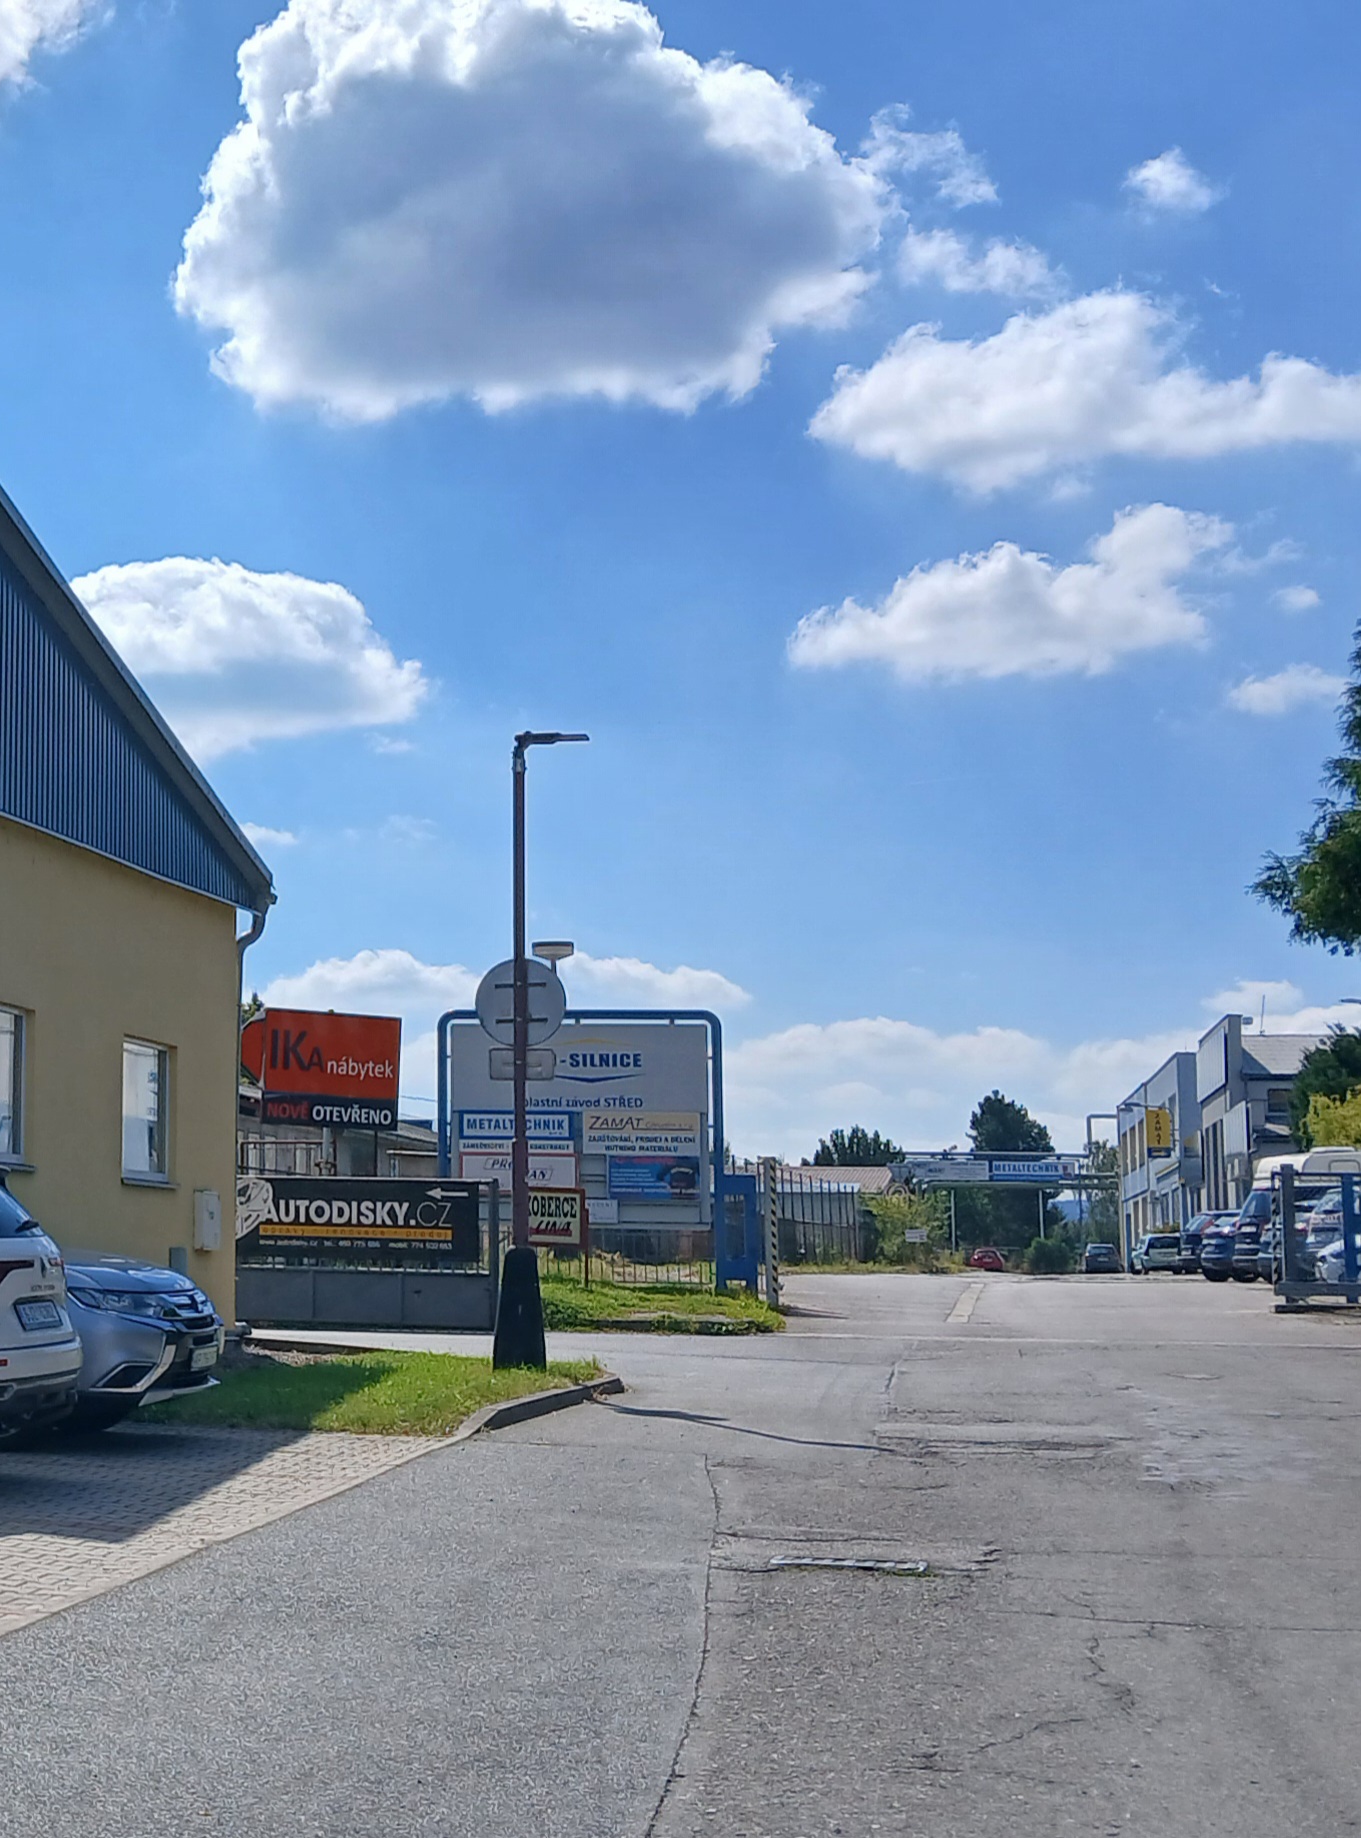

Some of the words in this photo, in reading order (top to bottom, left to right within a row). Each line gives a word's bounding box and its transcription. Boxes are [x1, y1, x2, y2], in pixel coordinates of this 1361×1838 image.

[327, 1056, 394, 1080] nábytek
[560, 1053, 642, 1068] -SILNICE
[604, 1096, 643, 1108] STŘED
[312, 1104, 392, 1125] OTEVŘENO
[466, 1118, 565, 1131] METALTCHNIK
[589, 1115, 644, 1130] ZAMAT
[263, 1199, 453, 1228] AUTODISKY.CZ
